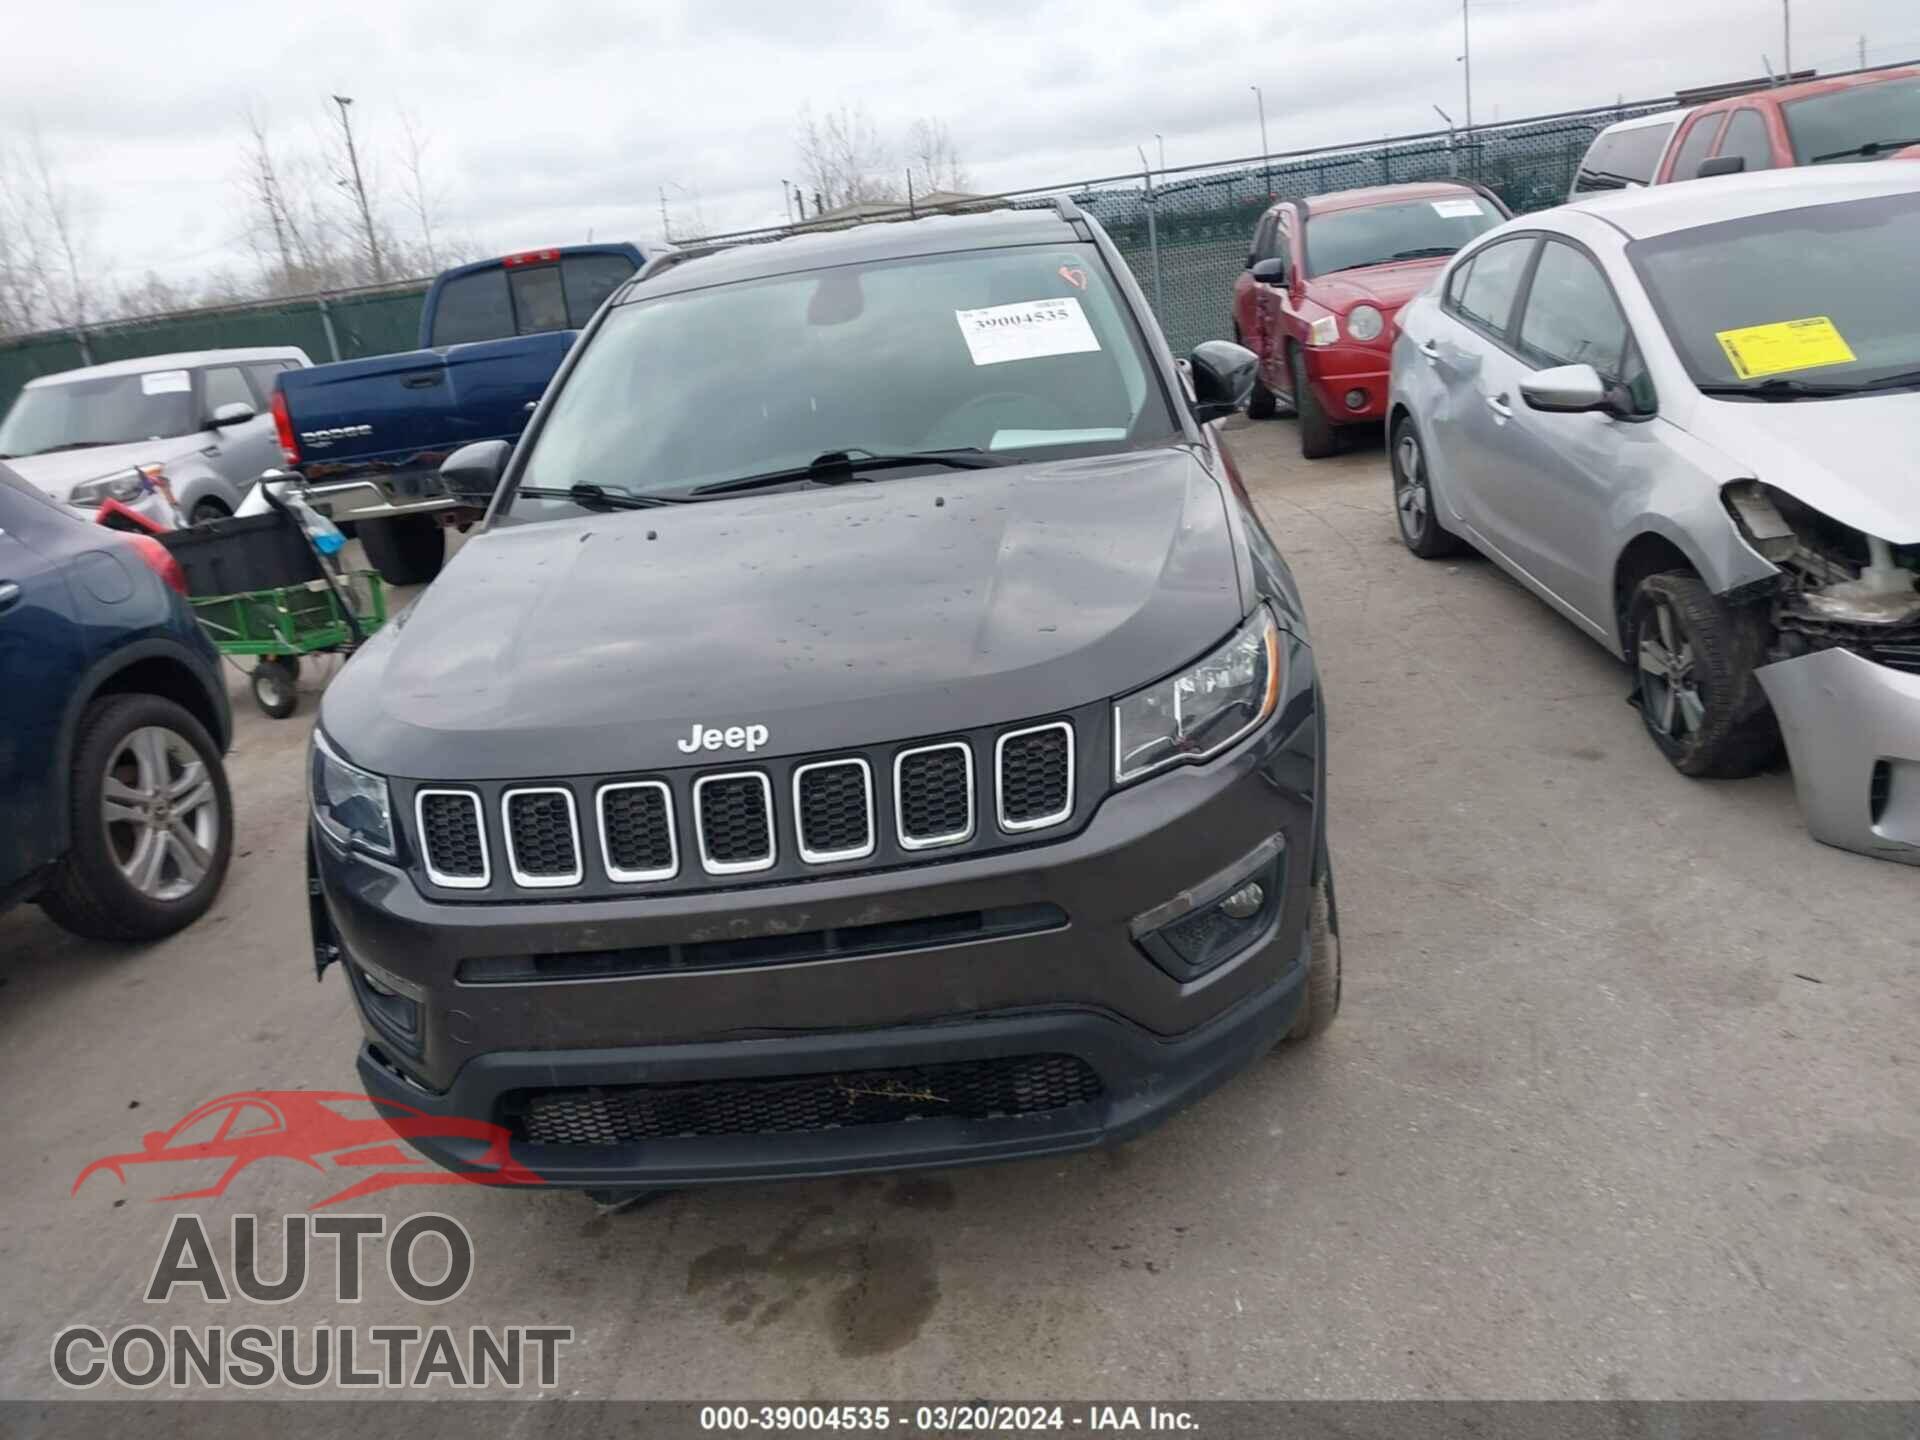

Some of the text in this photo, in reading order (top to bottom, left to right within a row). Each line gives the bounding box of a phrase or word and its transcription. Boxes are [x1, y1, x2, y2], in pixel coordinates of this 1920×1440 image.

[975, 309, 1069, 328] 39004535
[301, 424, 372, 442] DODGE
[677, 724, 769, 753] Jeep
